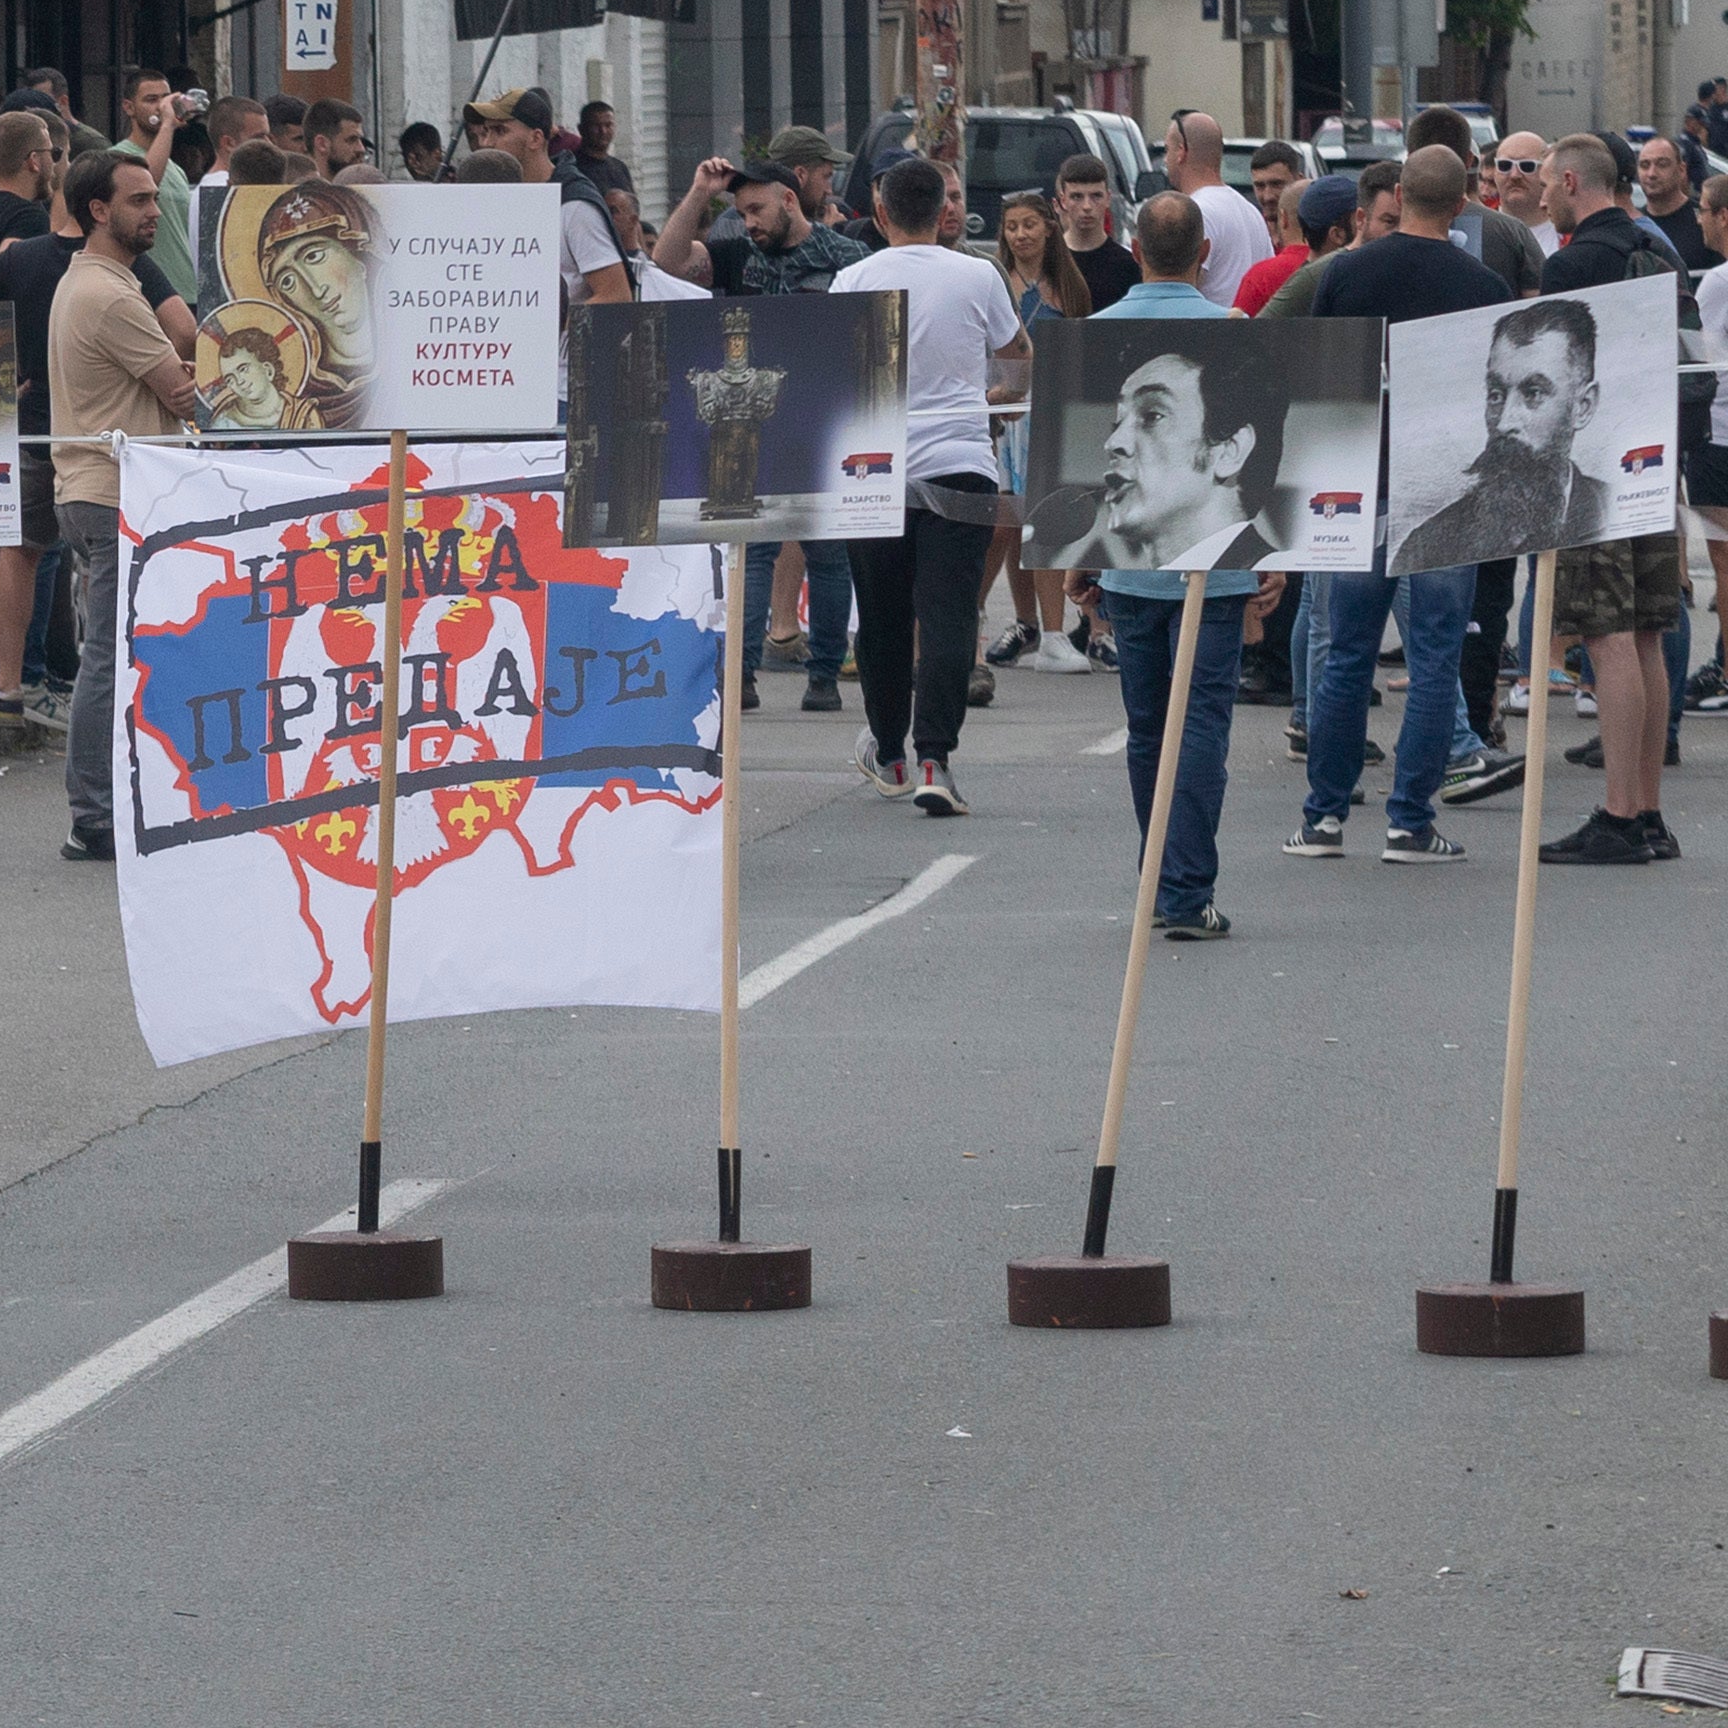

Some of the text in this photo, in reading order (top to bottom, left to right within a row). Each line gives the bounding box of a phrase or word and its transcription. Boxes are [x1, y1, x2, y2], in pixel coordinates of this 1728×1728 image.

[389, 238, 541, 257] У СЛУЧАЈУ ДА
[446, 264, 483, 281] СТЕ
[388, 290, 539, 308] ЗАБОРАВИЛИ
[429, 316, 500, 334] ПРАВУ
[416, 343, 512, 360] КУЛТУРУ
[412, 369, 515, 386] КОСМЕТА
[241, 523, 540, 625] НЕМА
[185, 638, 667, 772] ПРЕДАЈЕ
